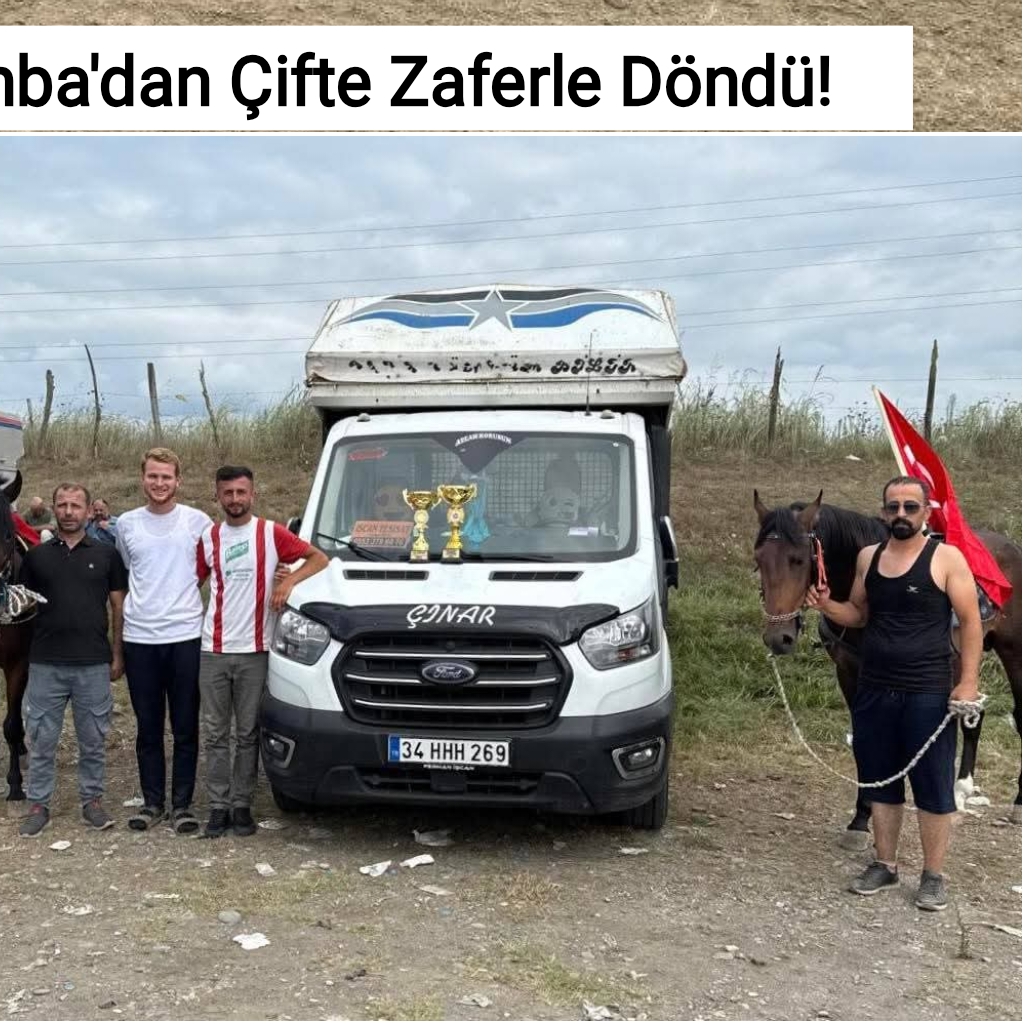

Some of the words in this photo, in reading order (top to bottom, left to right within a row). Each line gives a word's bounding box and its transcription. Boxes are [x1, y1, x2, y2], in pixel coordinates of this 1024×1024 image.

[406, 604, 496, 629] ÇINAR
[433, 666, 462, 678] Ford
[402, 741, 424, 759] 34
[430, 742, 465, 761] HHH
[471, 744, 506, 763] 269
